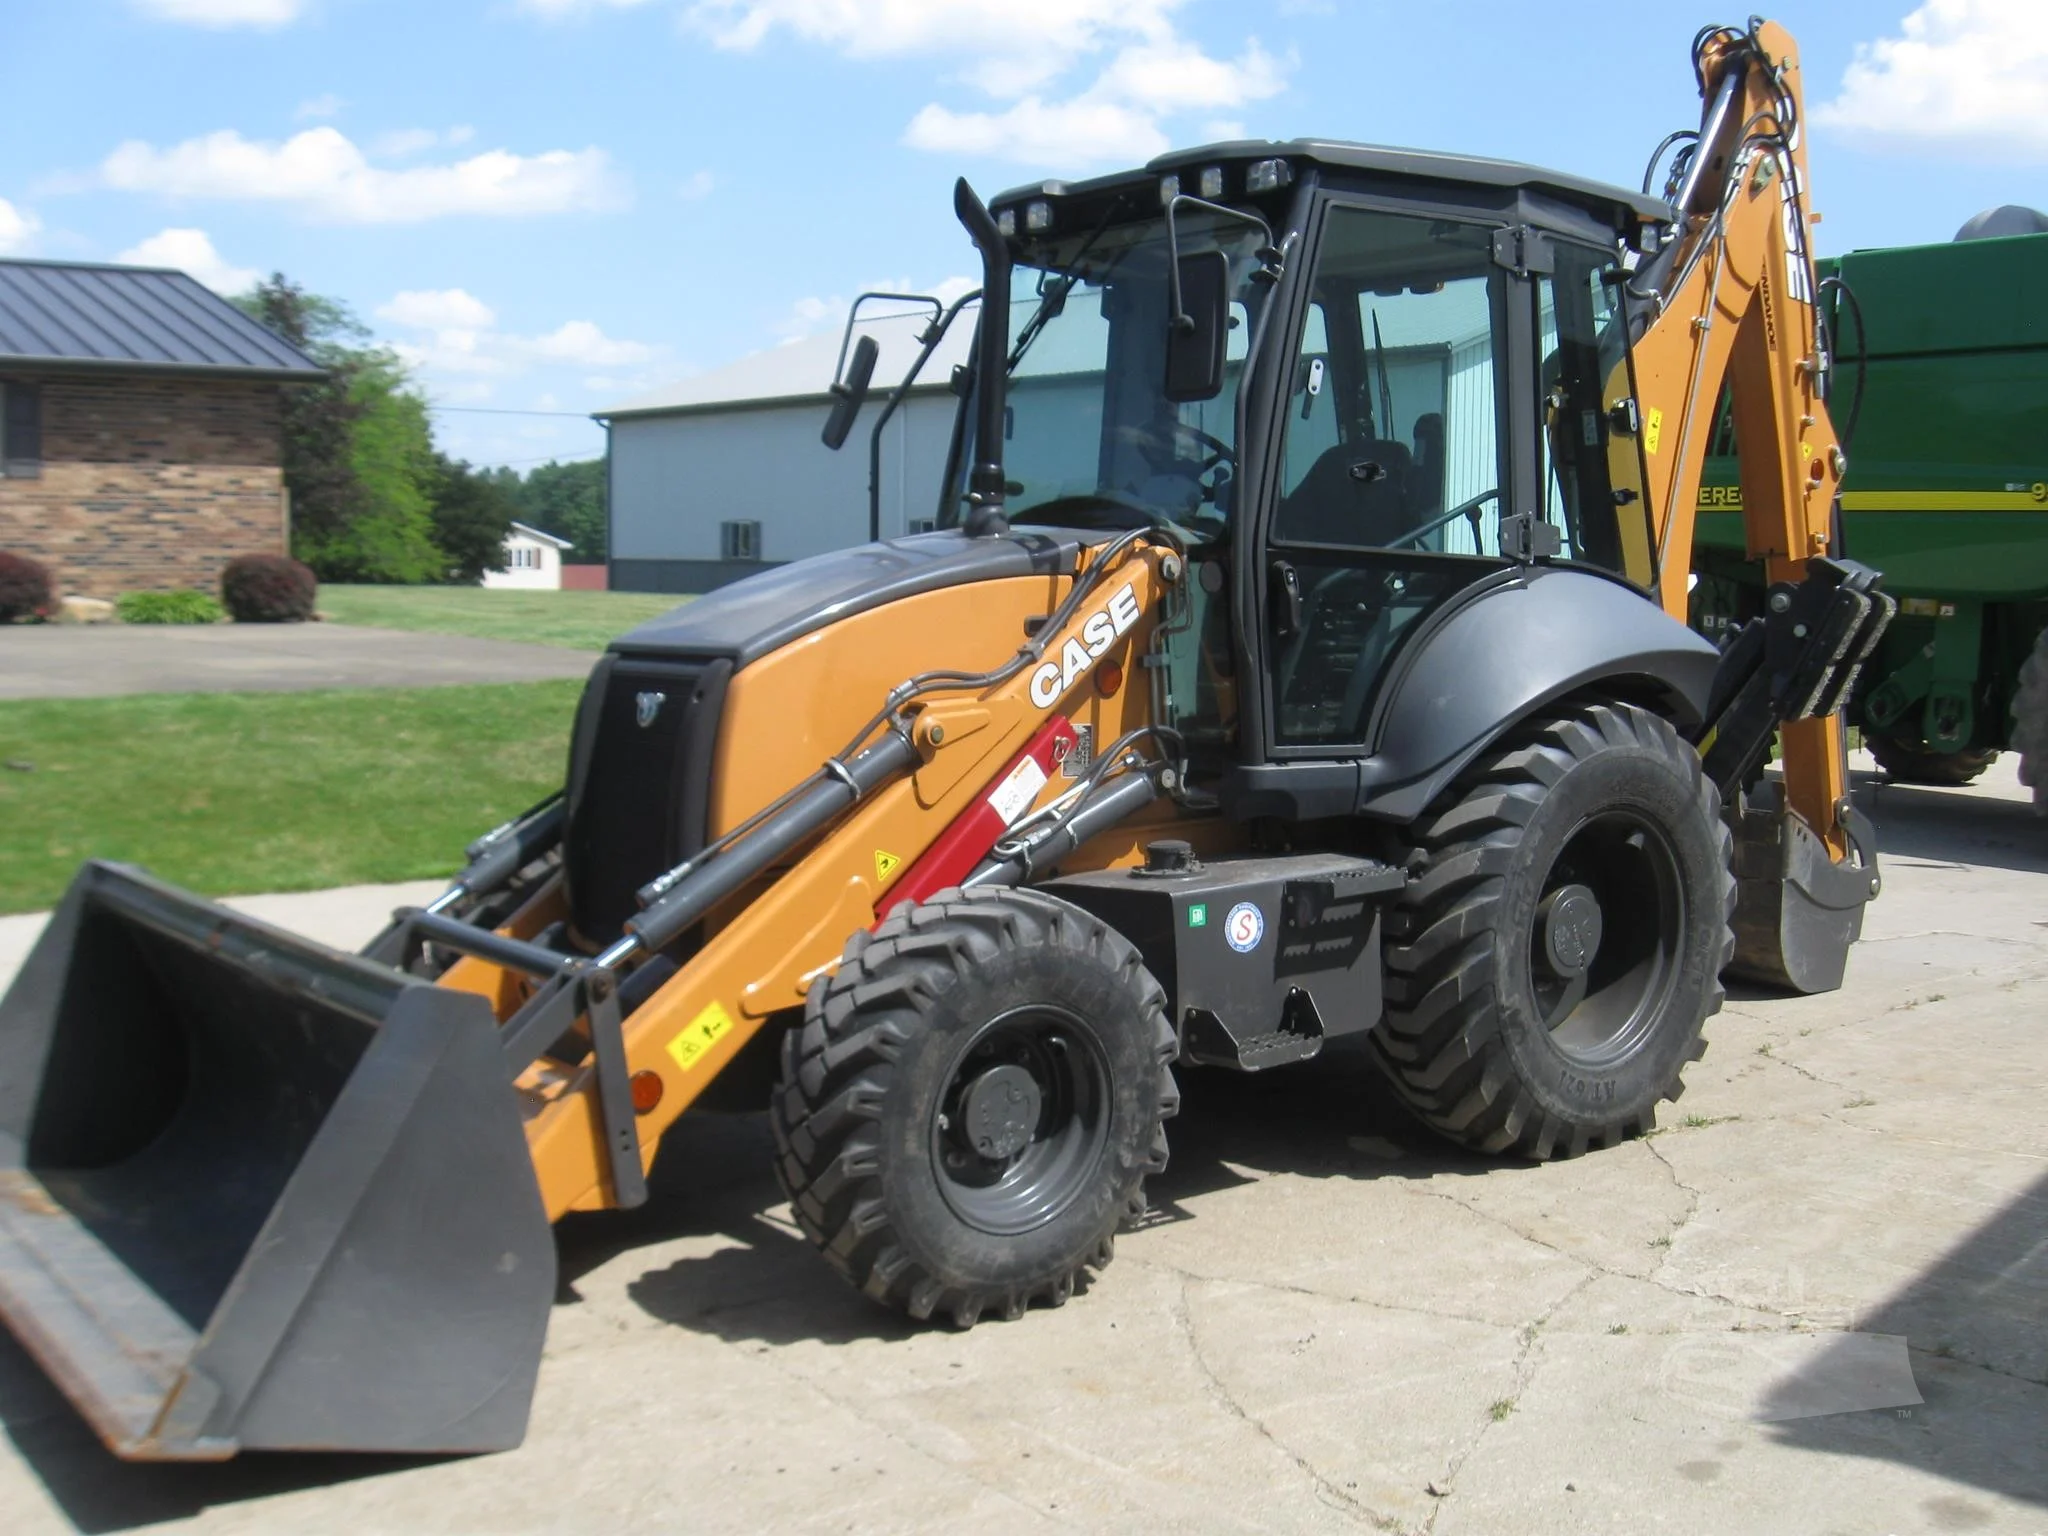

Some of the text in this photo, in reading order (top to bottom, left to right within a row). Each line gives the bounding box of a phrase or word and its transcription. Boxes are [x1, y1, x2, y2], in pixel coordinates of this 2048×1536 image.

[1699, 486, 1740, 504] ERE
[2031, 482, 2048, 500] 9
[1030, 582, 1140, 709] CASE
